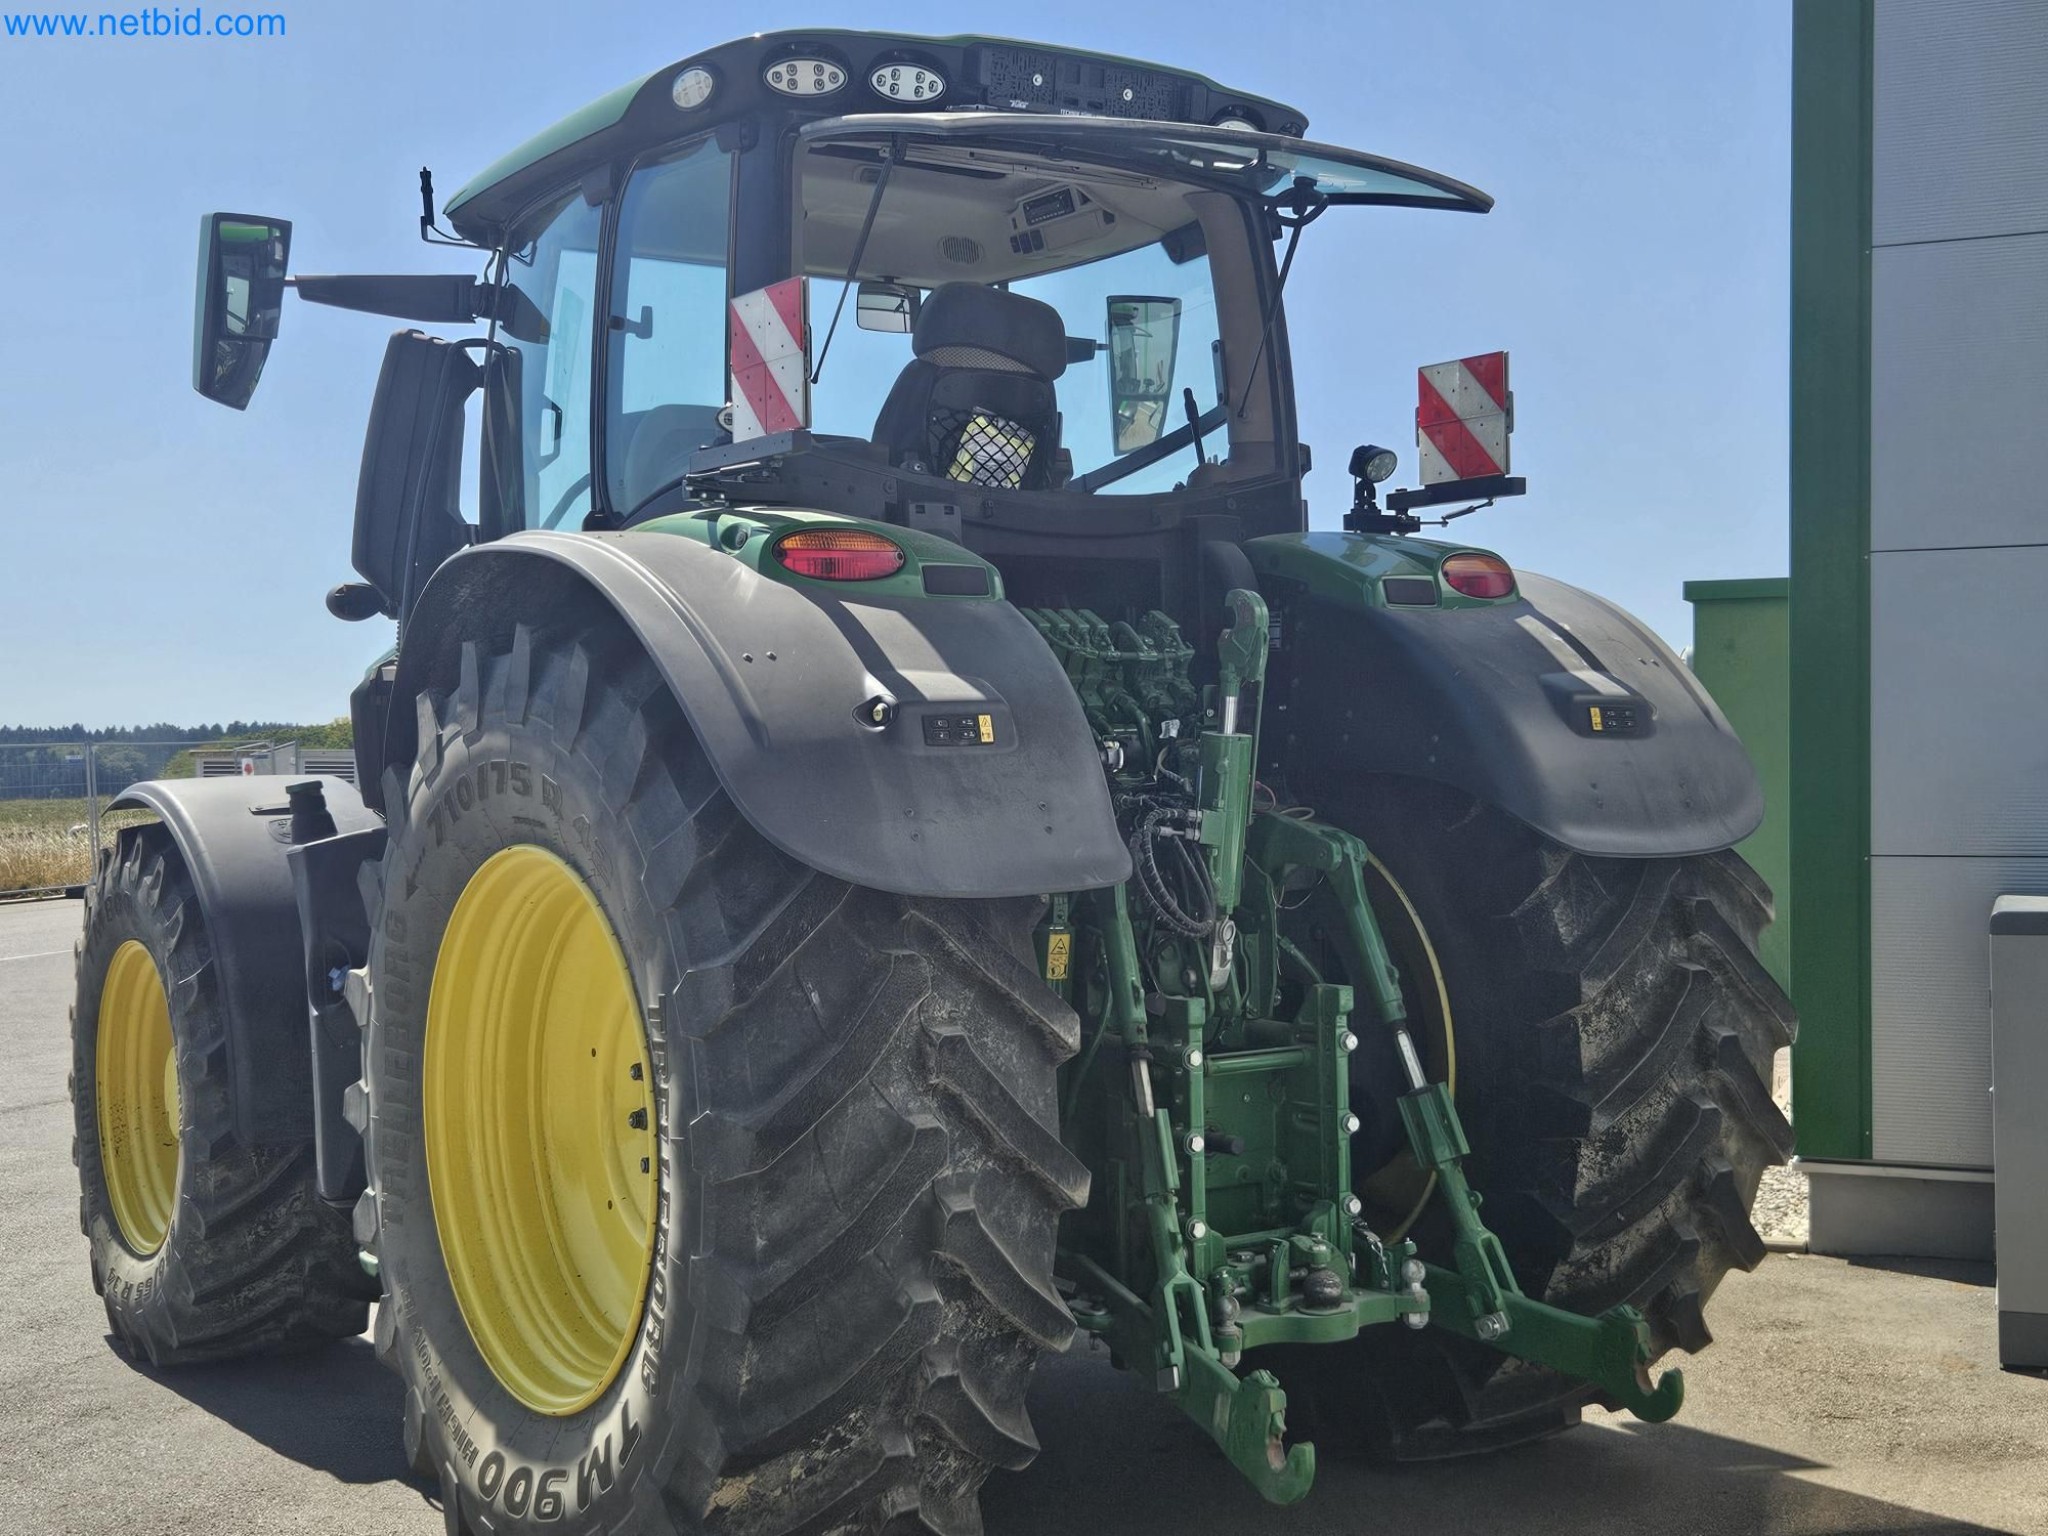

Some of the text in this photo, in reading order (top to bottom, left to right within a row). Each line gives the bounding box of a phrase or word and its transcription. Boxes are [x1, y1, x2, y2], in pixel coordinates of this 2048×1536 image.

[426, 758, 534, 848] 710/75
[639, 992, 672, 1399] TRELLEBORG
[437, 1391, 481, 1469] HIGH
